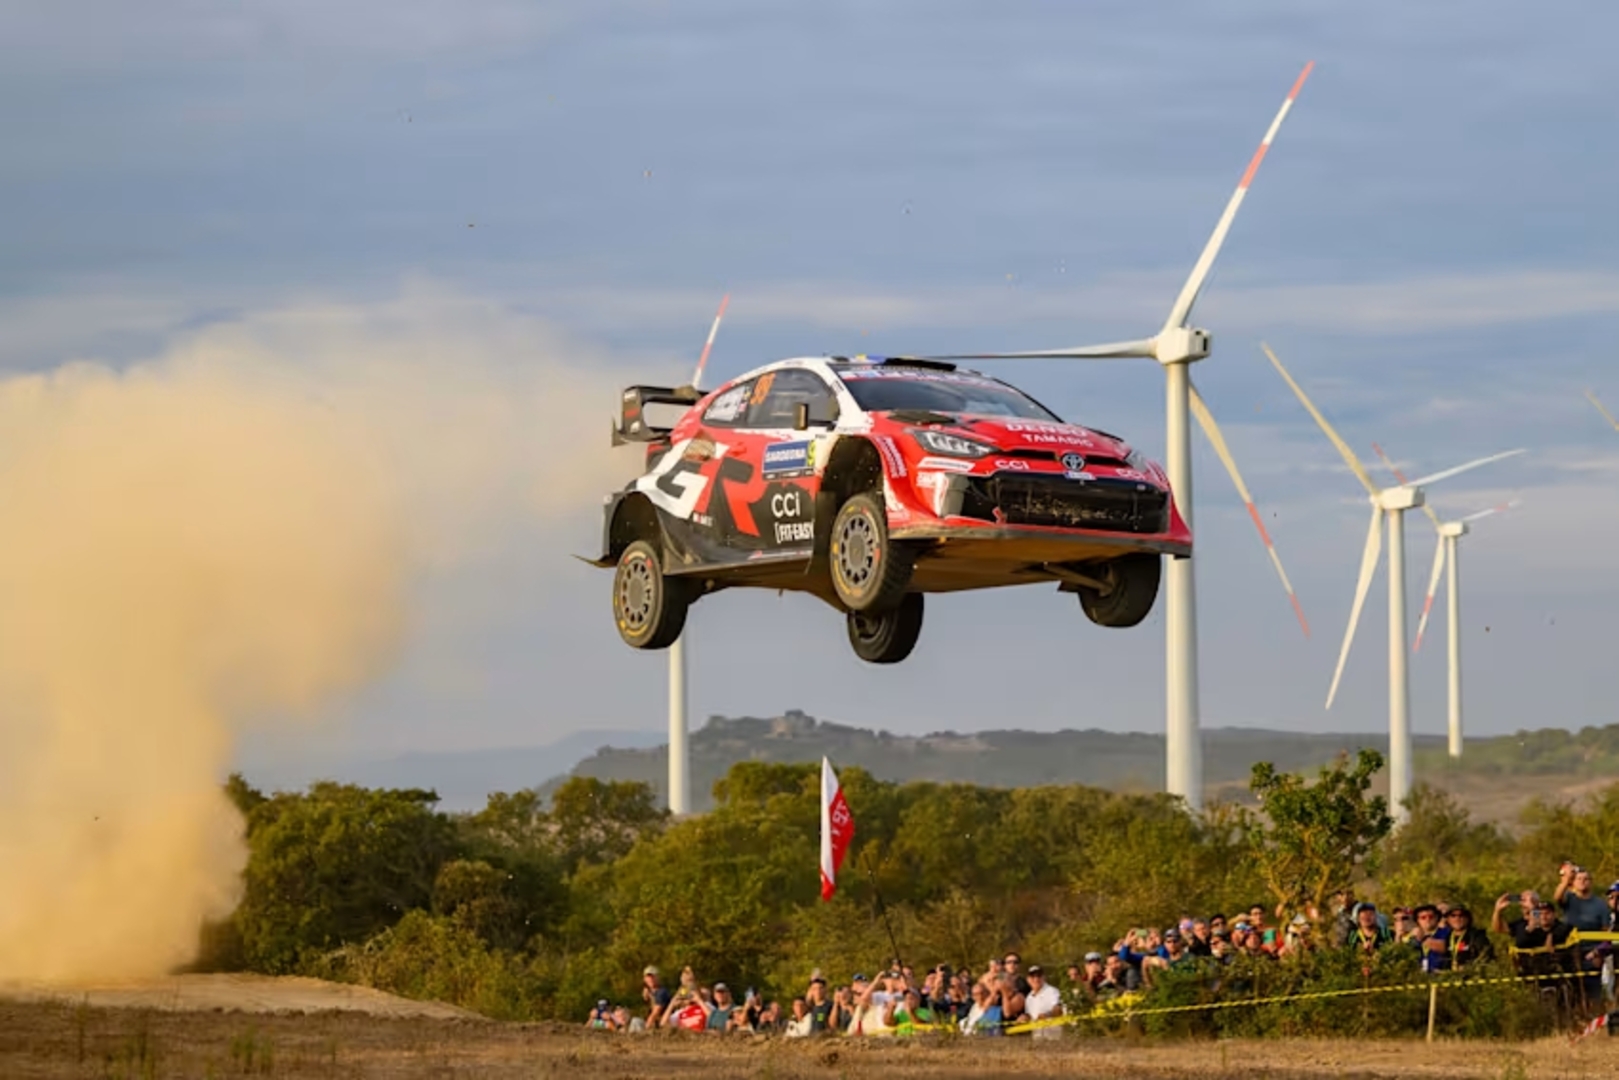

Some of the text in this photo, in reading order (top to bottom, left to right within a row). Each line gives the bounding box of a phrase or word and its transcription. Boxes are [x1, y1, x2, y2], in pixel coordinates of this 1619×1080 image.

[1005, 423, 1089, 438] DENSO
[1021, 433, 1095, 448] TAMADIC
[635, 438, 769, 538] GR
